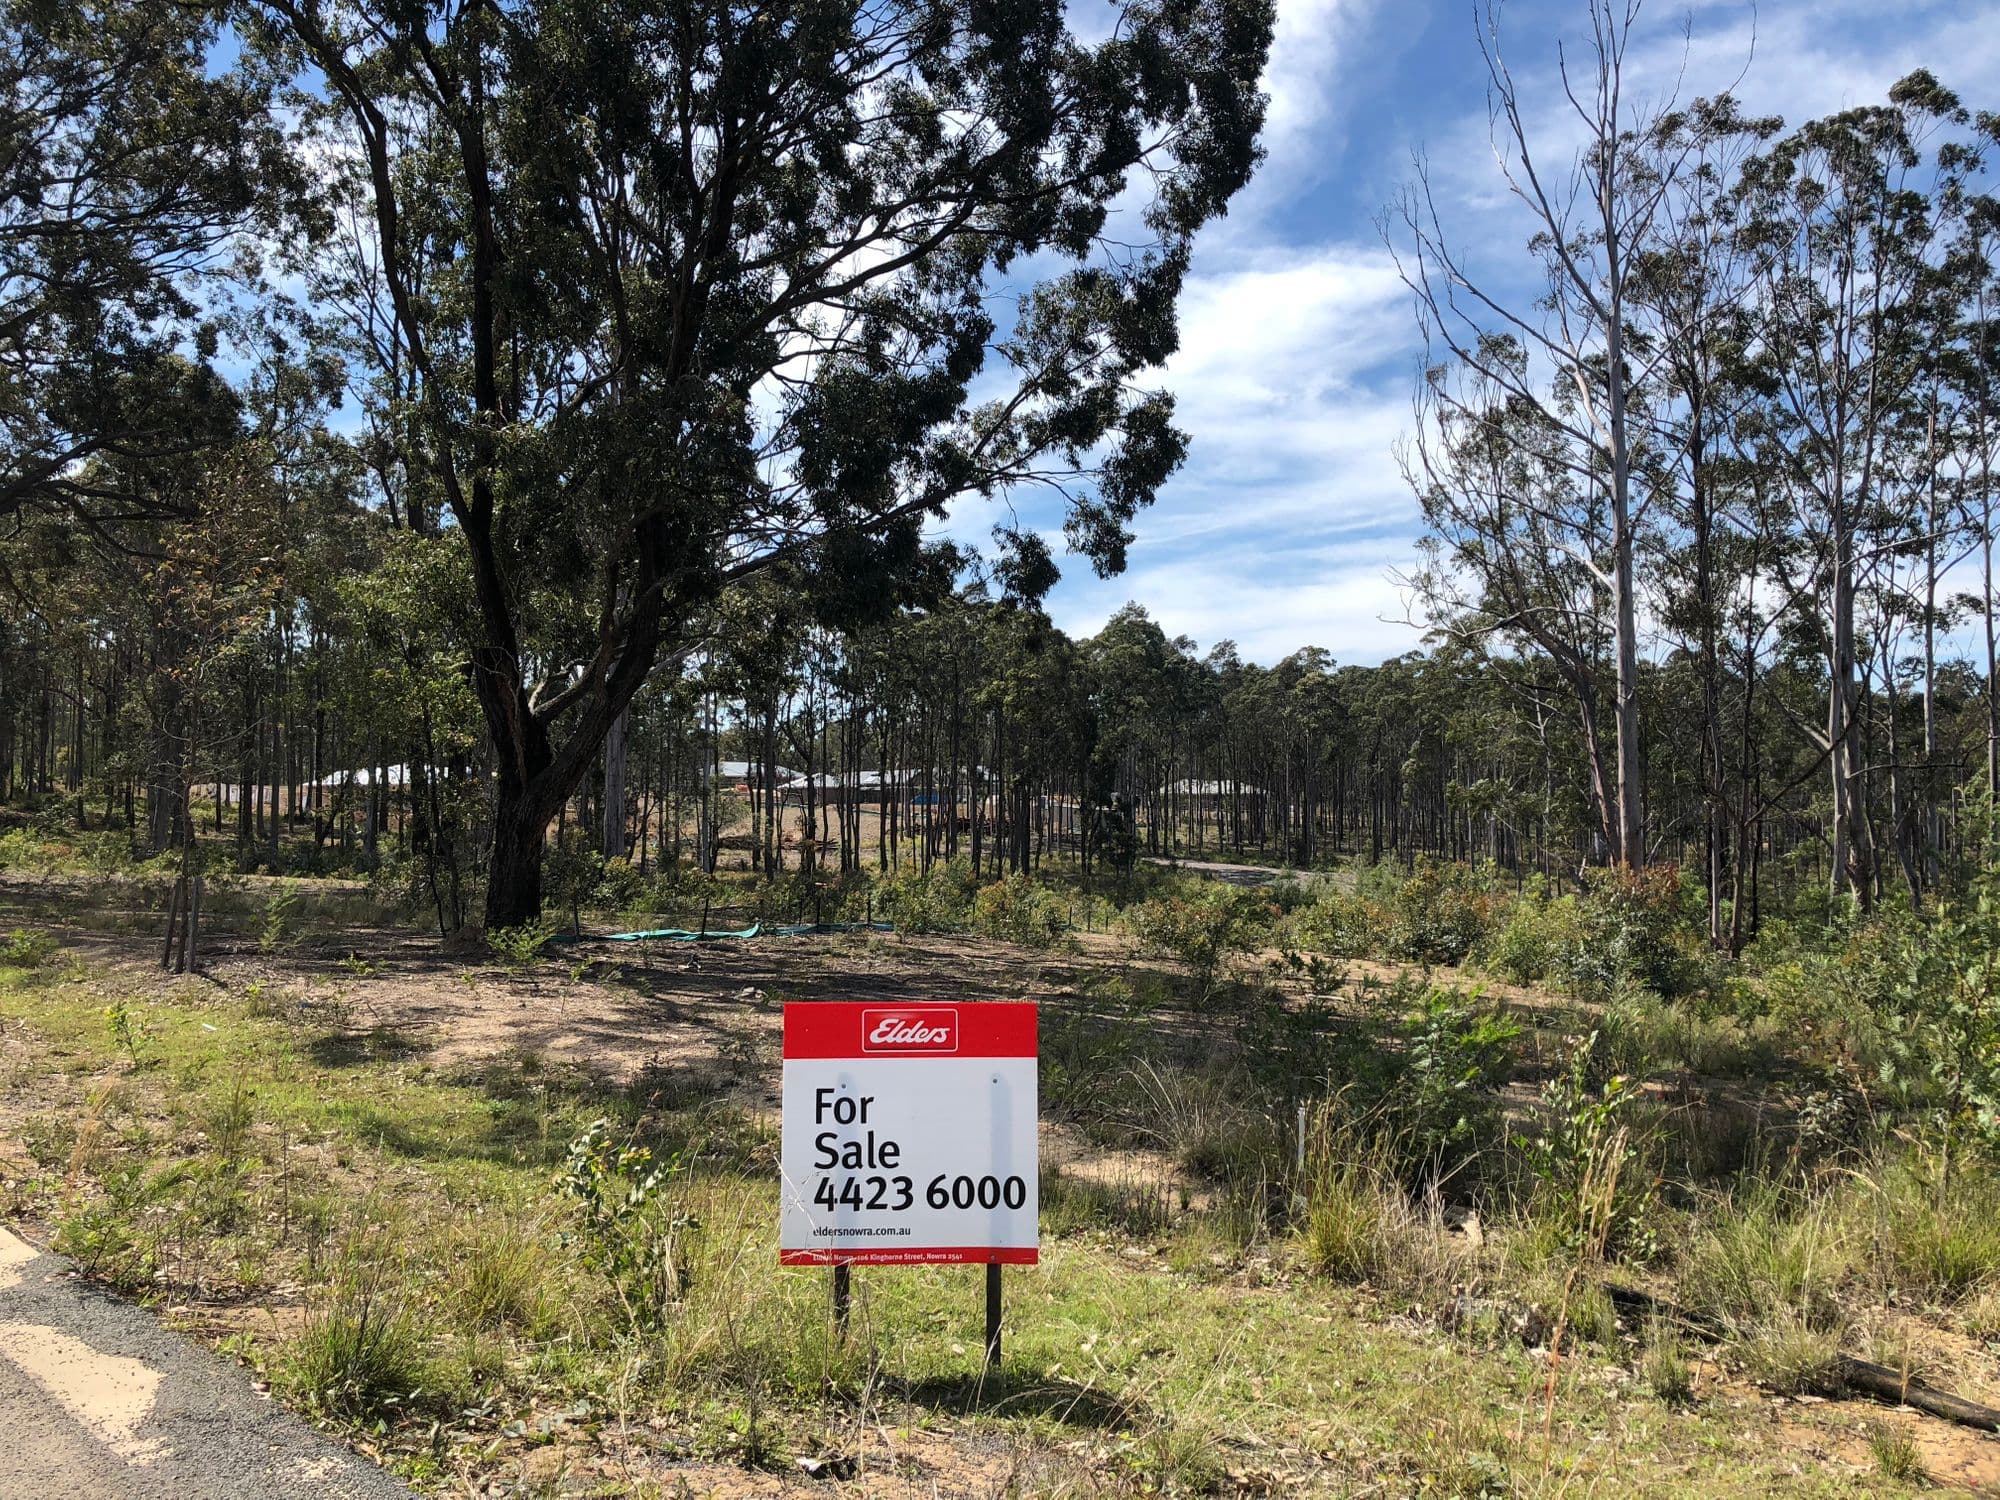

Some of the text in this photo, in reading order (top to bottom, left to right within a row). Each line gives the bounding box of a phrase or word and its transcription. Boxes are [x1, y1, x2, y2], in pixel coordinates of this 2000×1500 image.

[869, 1018, 951, 1044] Elders
[815, 1087, 875, 1125] For
[813, 1130, 901, 1170] Sale
[813, 1173, 1027, 1212] 4423 6000
[813, 1226, 911, 1237] eldersnowra.com.au
